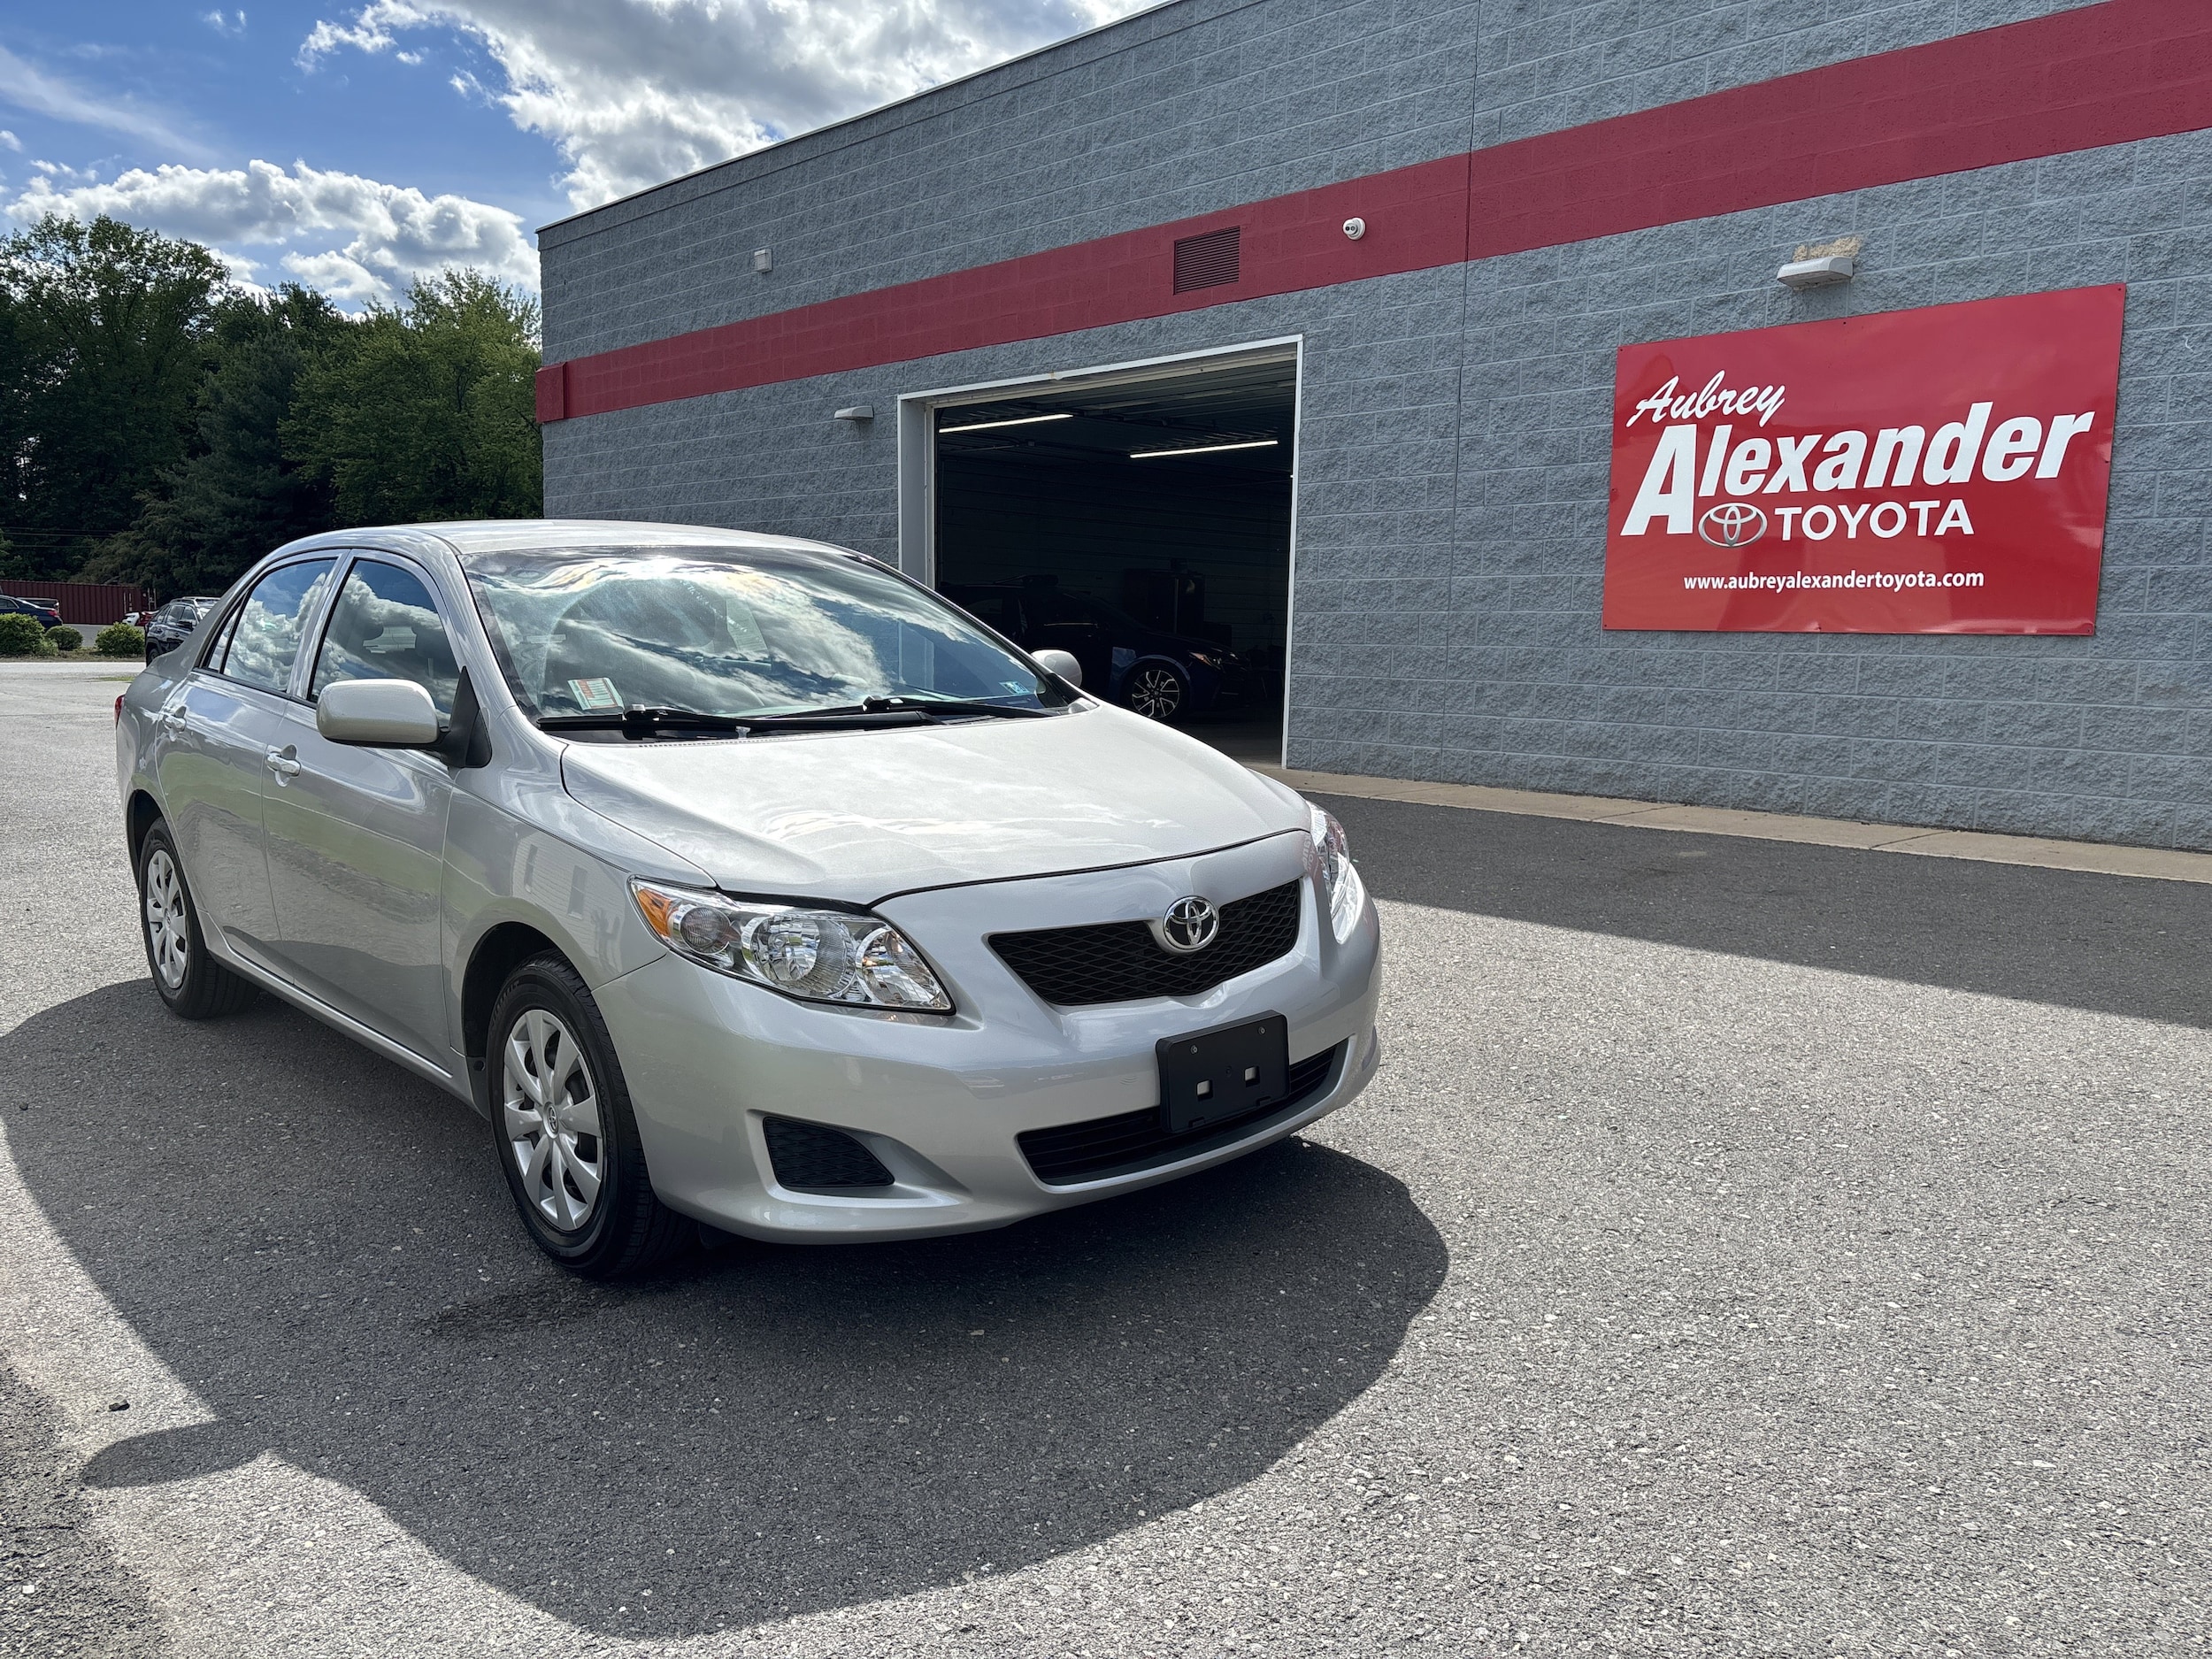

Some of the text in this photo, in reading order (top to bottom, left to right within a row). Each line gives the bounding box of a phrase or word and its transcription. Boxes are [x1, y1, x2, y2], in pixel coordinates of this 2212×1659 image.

[1626, 370, 1786, 426] Aubrey
[1620, 401, 2095, 536] Alexander
[1774, 498, 1975, 541] TOYOTA
[1683, 569, 1985, 594] www.aubreyalexandertoyota.com
